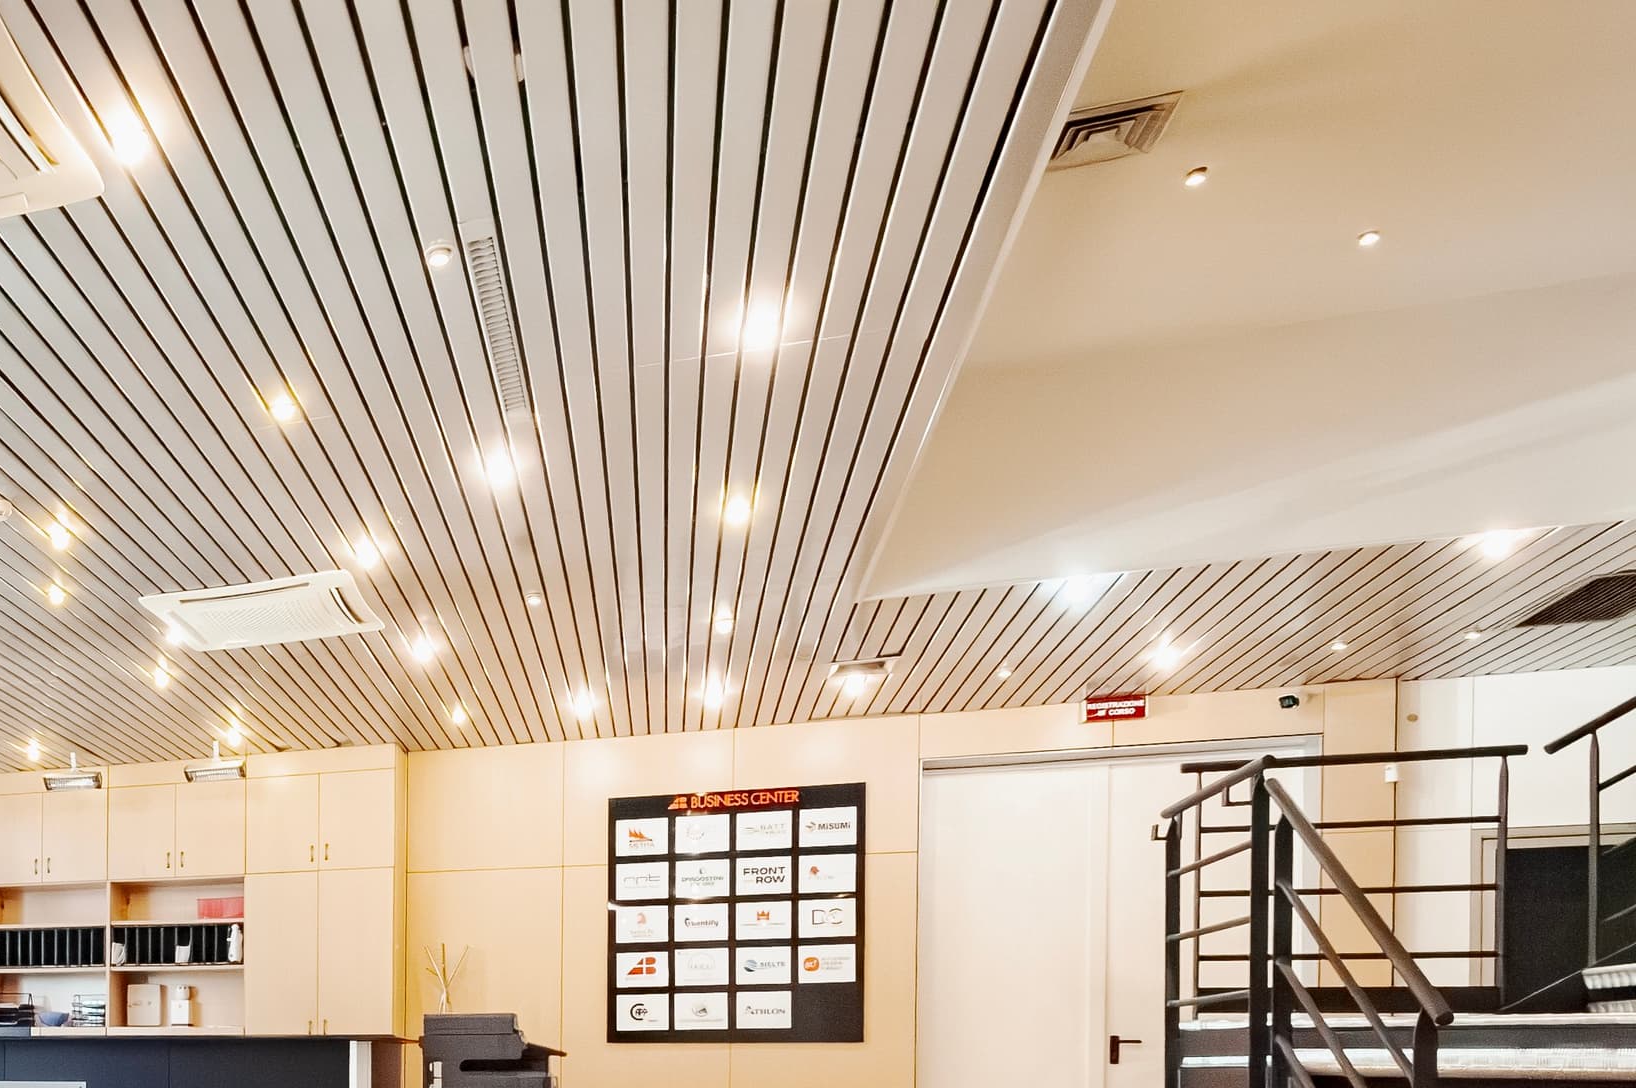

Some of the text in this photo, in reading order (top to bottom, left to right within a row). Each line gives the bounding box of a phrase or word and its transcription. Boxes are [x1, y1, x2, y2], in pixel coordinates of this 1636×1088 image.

[690, 794, 748, 809] BUSINESS
[750, 790, 799, 805] CENTER
[744, 866, 786, 875] FRONT
[756, 875, 785, 884] ROW
